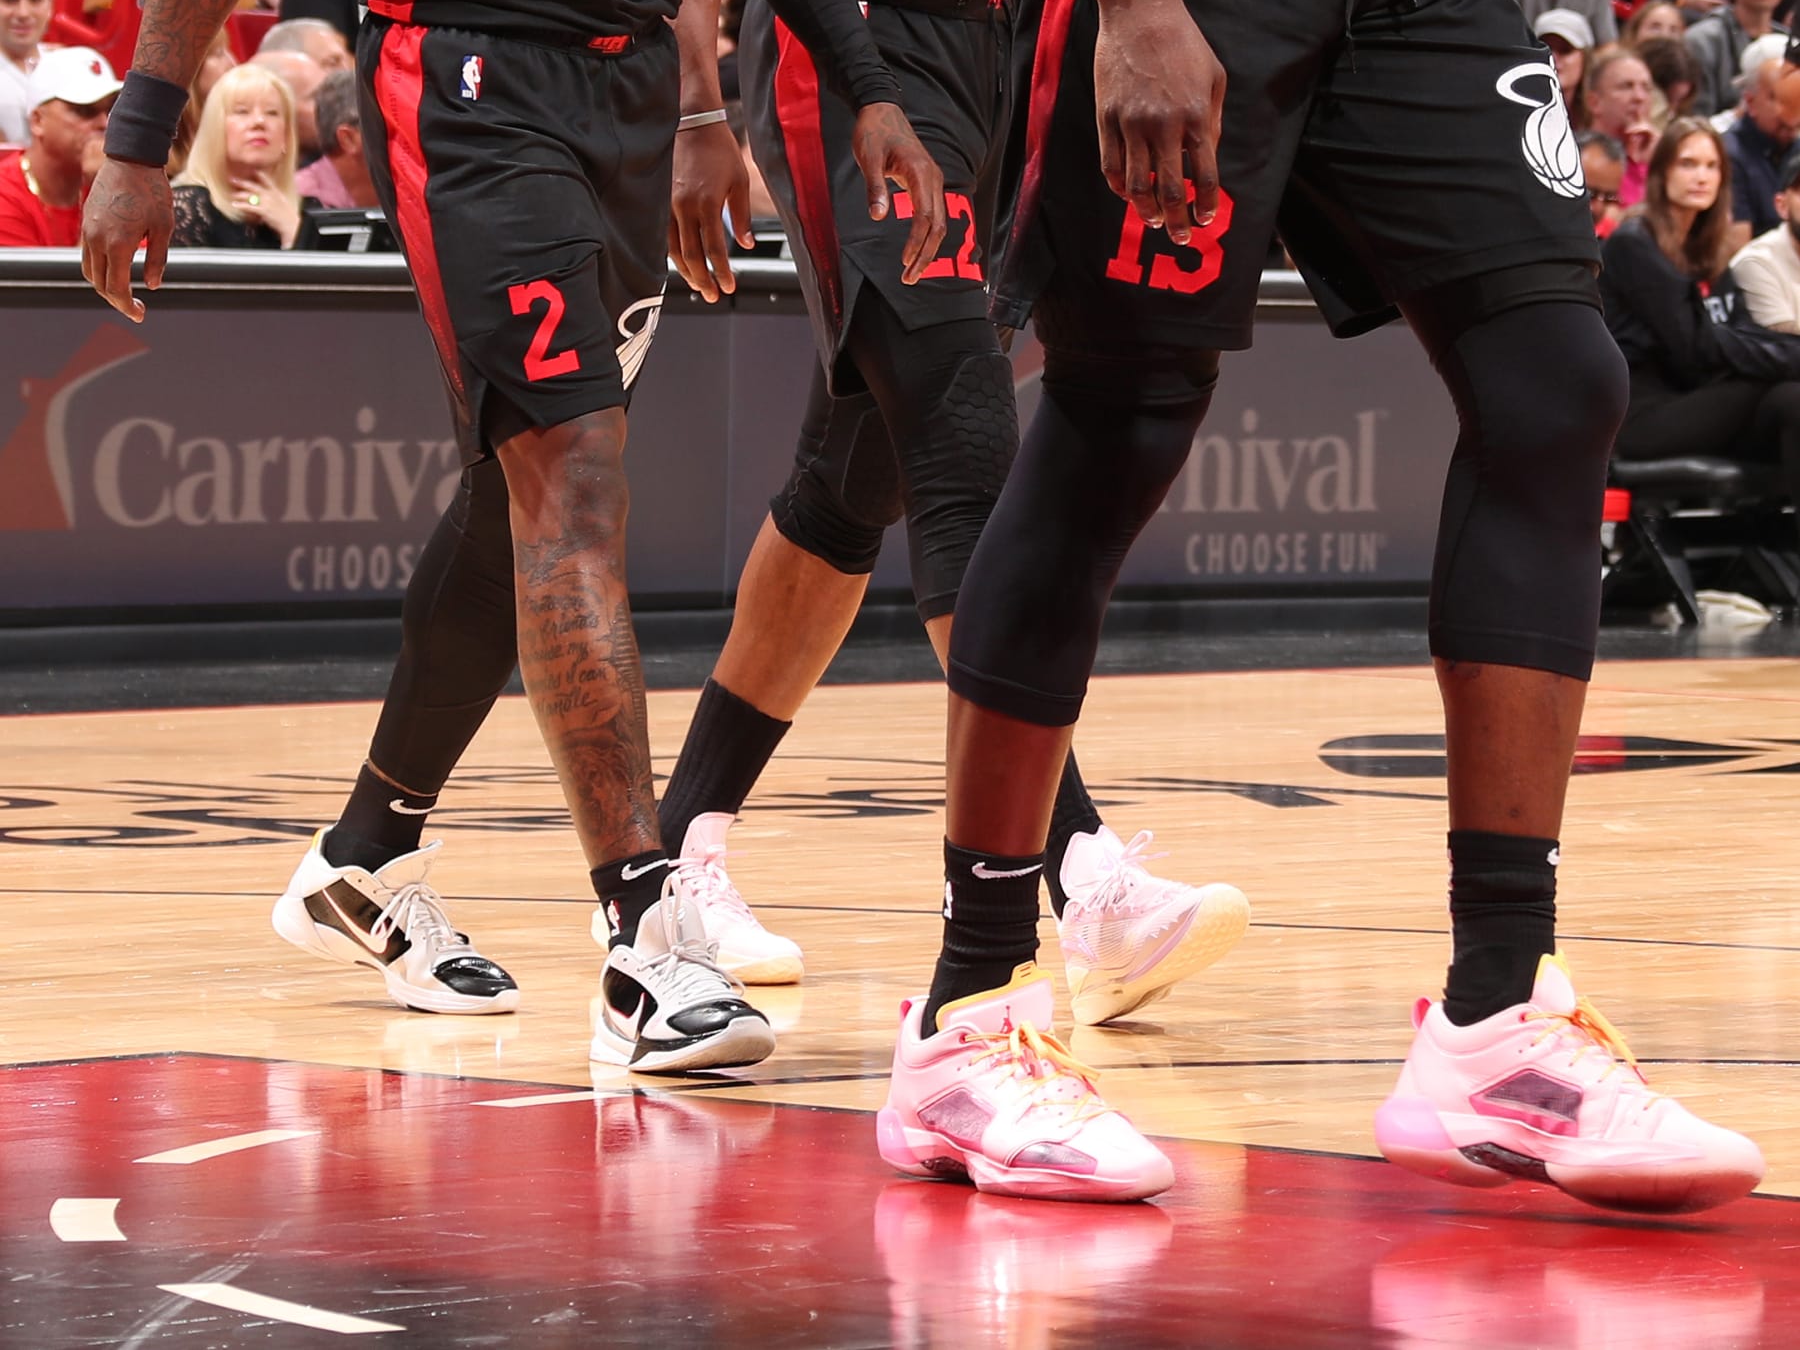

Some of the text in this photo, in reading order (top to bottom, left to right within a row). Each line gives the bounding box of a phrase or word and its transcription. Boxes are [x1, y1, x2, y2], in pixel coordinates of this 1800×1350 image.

[1105, 171, 1236, 295] 13
[507, 279, 582, 382] 2
[94, 406, 461, 529] Carniva
[1160, 408, 1379, 515] nival
[286, 545, 420, 591] CHOOS
[1184, 531, 1378, 576] CHOOSE FUN
